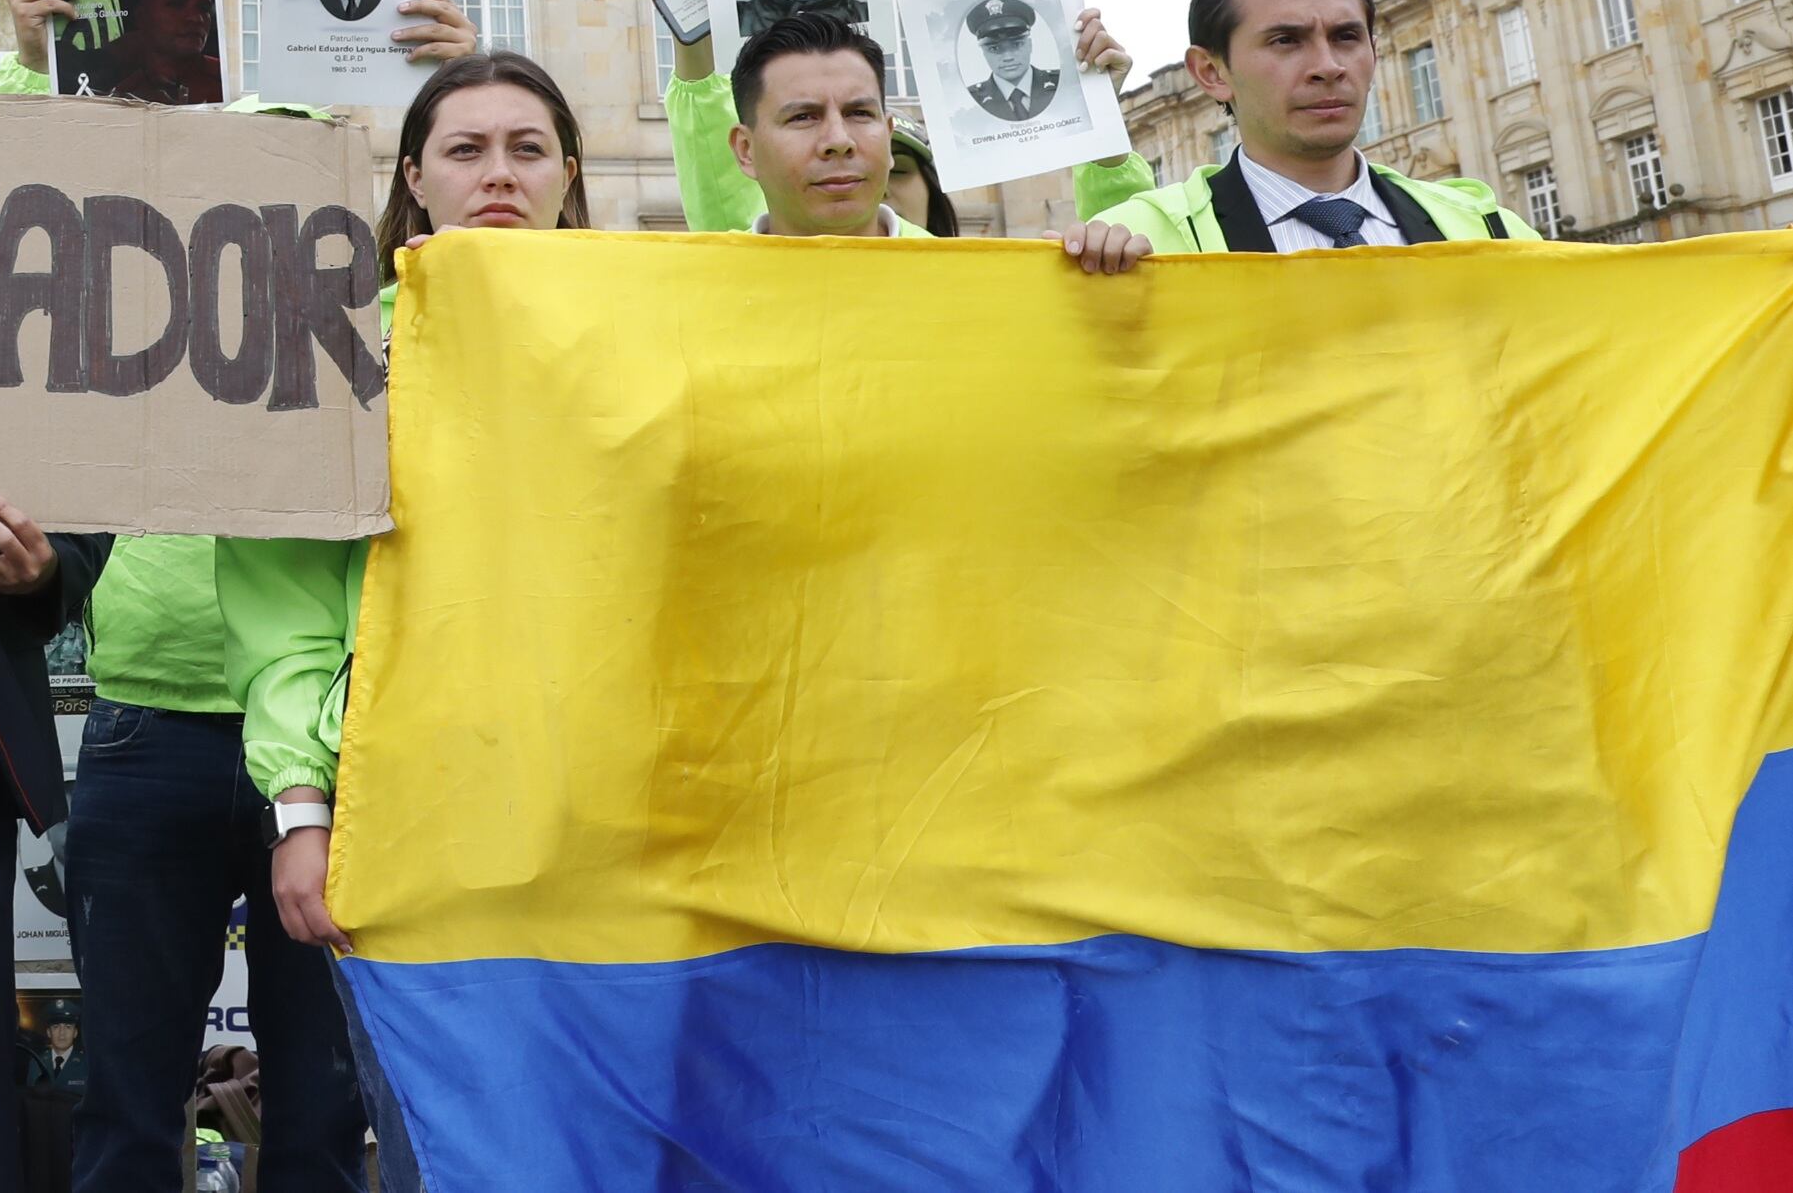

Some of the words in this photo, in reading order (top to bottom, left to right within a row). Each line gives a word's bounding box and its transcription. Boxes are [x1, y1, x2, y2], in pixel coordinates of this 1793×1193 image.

[330, 34, 369, 43] Patrullero
[318, 45, 354, 53] Eduardo
[356, 45, 386, 55] Lengua
[996, 128, 1033, 141] ARNOLDO
[1033, 123, 1055, 134] CARO
[16, 930, 44, 939] JOHAN
[45, 929, 70, 938] MIGUE
